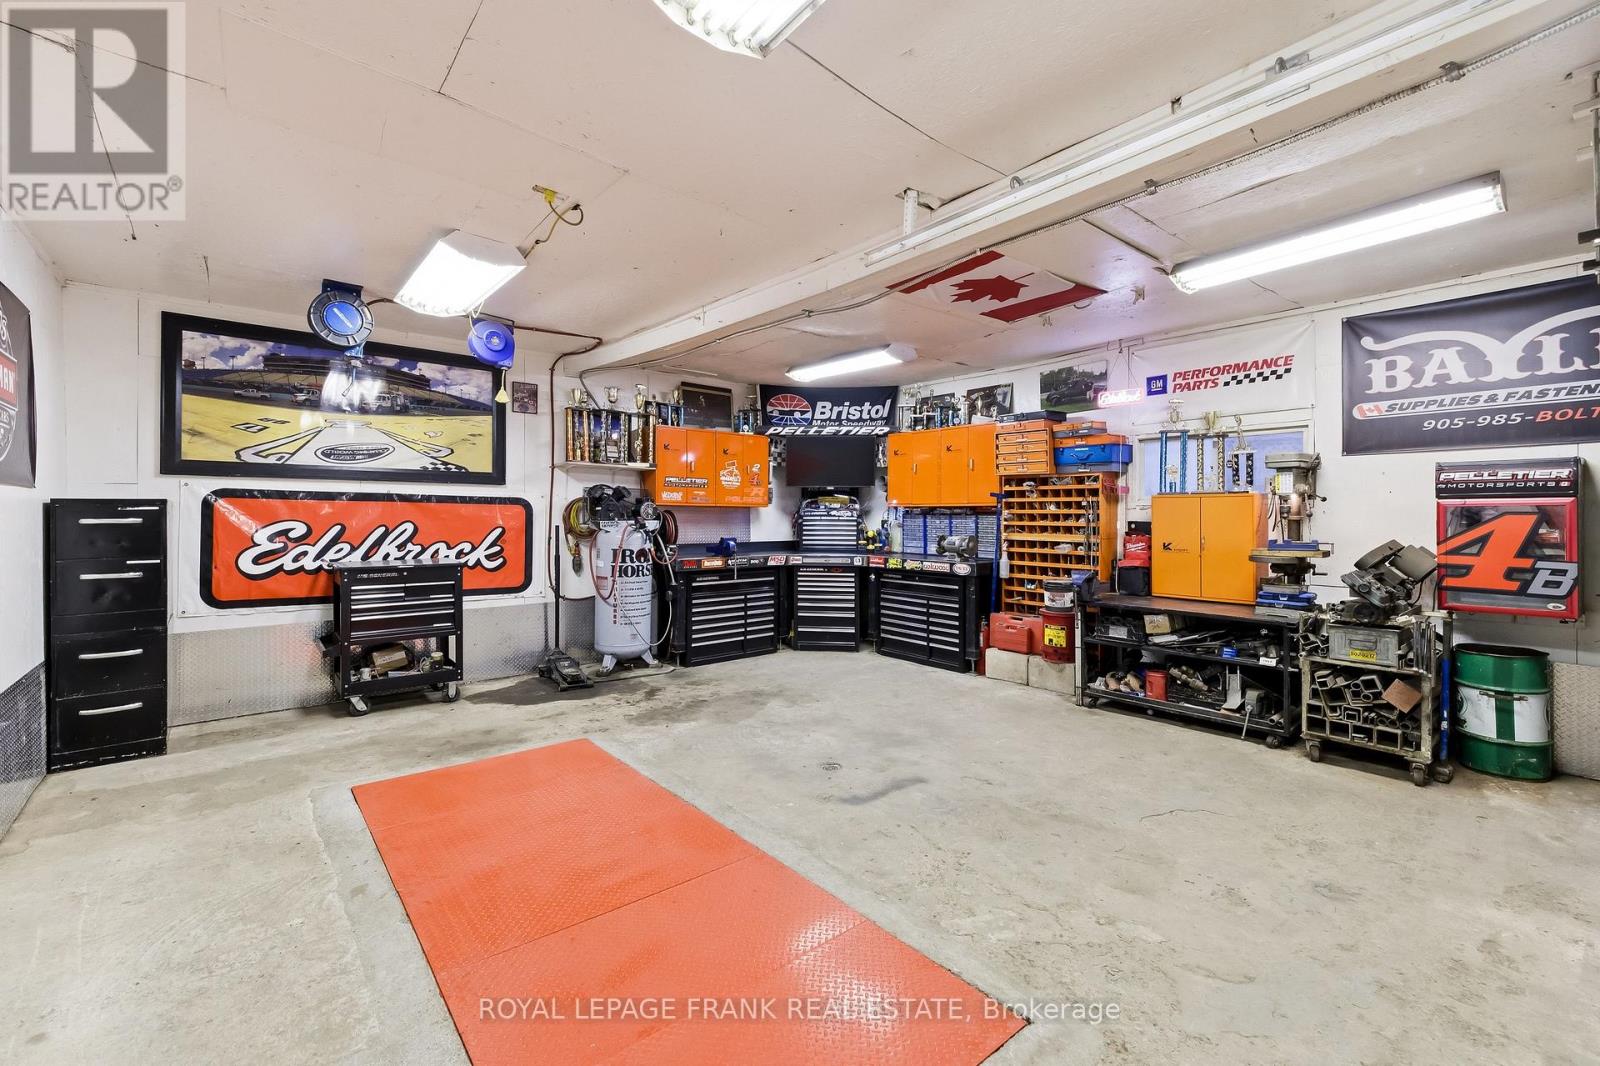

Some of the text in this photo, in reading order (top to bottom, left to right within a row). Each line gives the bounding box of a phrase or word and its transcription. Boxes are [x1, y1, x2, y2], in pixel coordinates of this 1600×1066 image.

[1361, 305, 1600, 394] BAYL
[1172, 355, 1295, 382] PERFORMANCE
[1151, 380, 1163, 391] GM
[1172, 378, 1219, 393] PARTS
[1384, 383, 1600, 413] SUPPLIES & FASTEN
[814, 399, 892, 420] Bristol
[765, 427, 891, 435] PELLETIER
[1439, 469, 1572, 481] PELLETIER
[237, 520, 505, 579] Edelbrock
[610, 564, 653, 578] HORS
